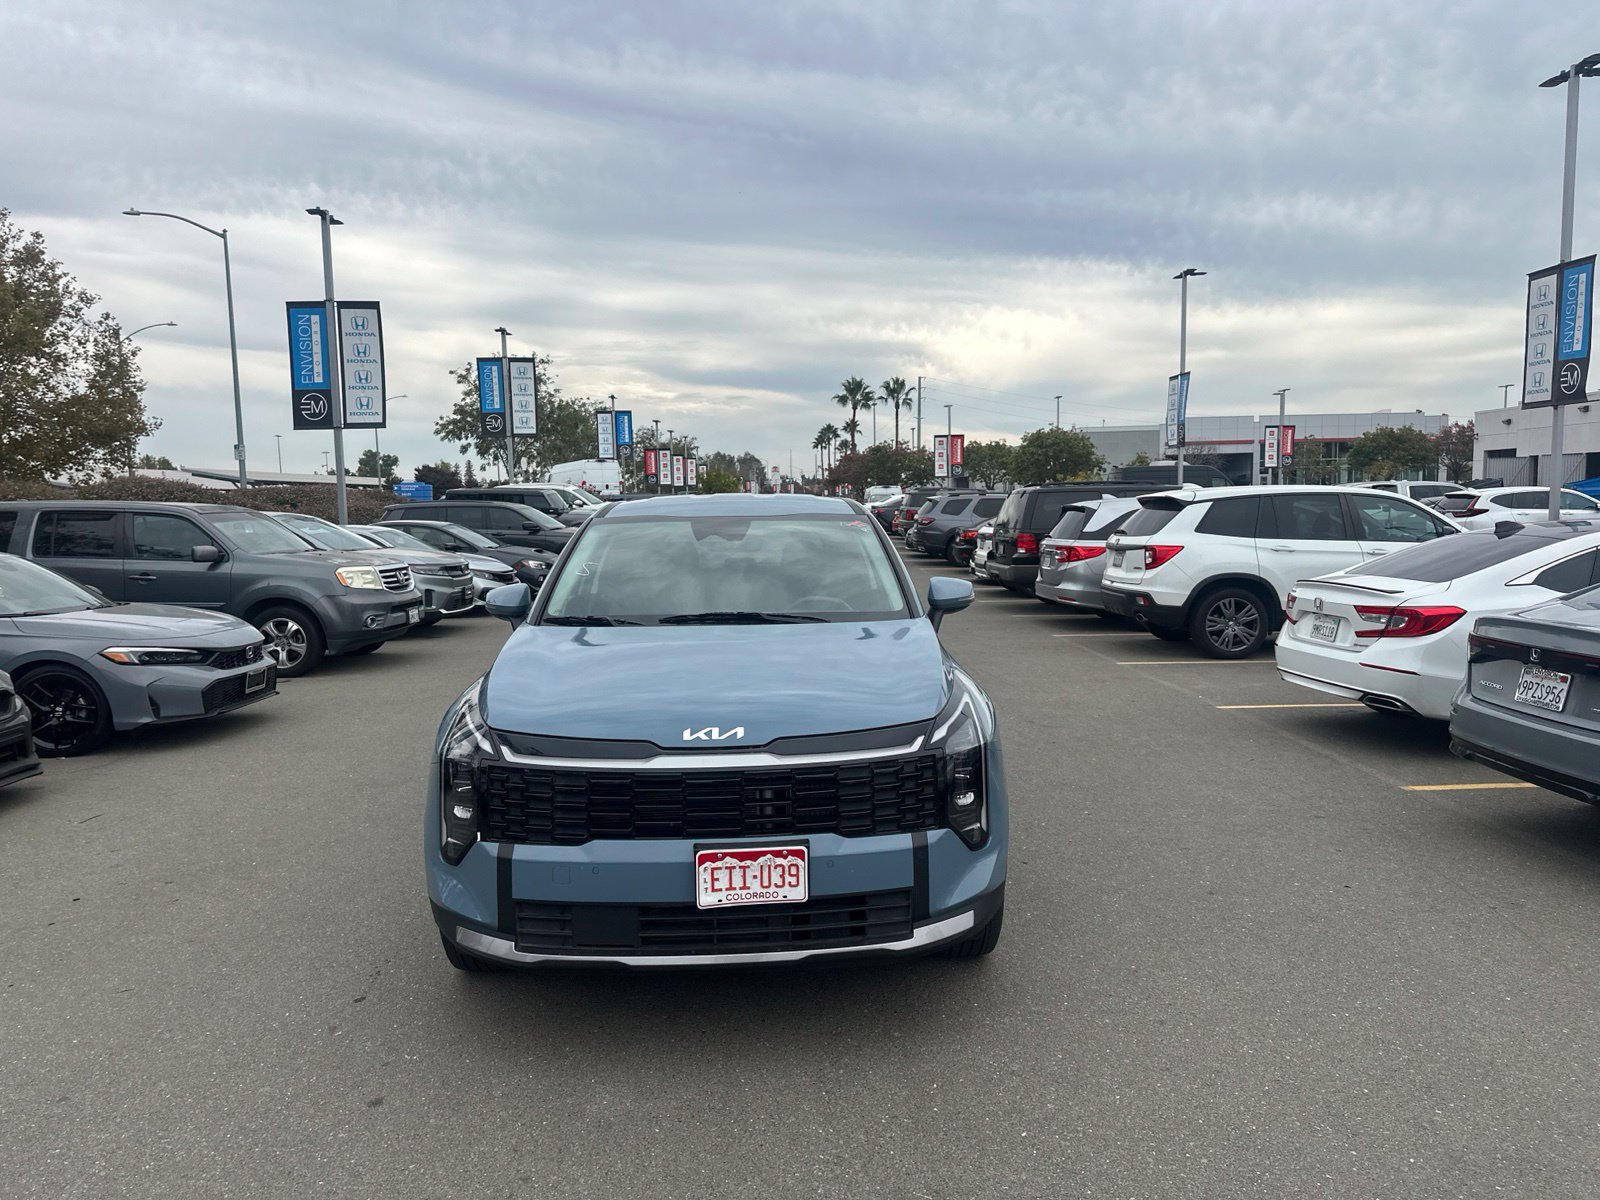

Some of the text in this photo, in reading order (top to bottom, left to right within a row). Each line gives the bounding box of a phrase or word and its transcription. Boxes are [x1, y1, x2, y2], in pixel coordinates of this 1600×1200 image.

[1531, 300, 1554, 310] HONDA
[1563, 274, 1579, 352] ENVISION
[1530, 330, 1552, 338] HONDA
[298, 314, 314, 384] ENVISION
[1529, 359, 1551, 367] HONDA
[484, 366, 493, 409] ENVISION
[1520, 680, 1564, 704] 9PZS956
[683, 726, 744, 741] KIA
[726, 891, 779, 901] COLORADO
